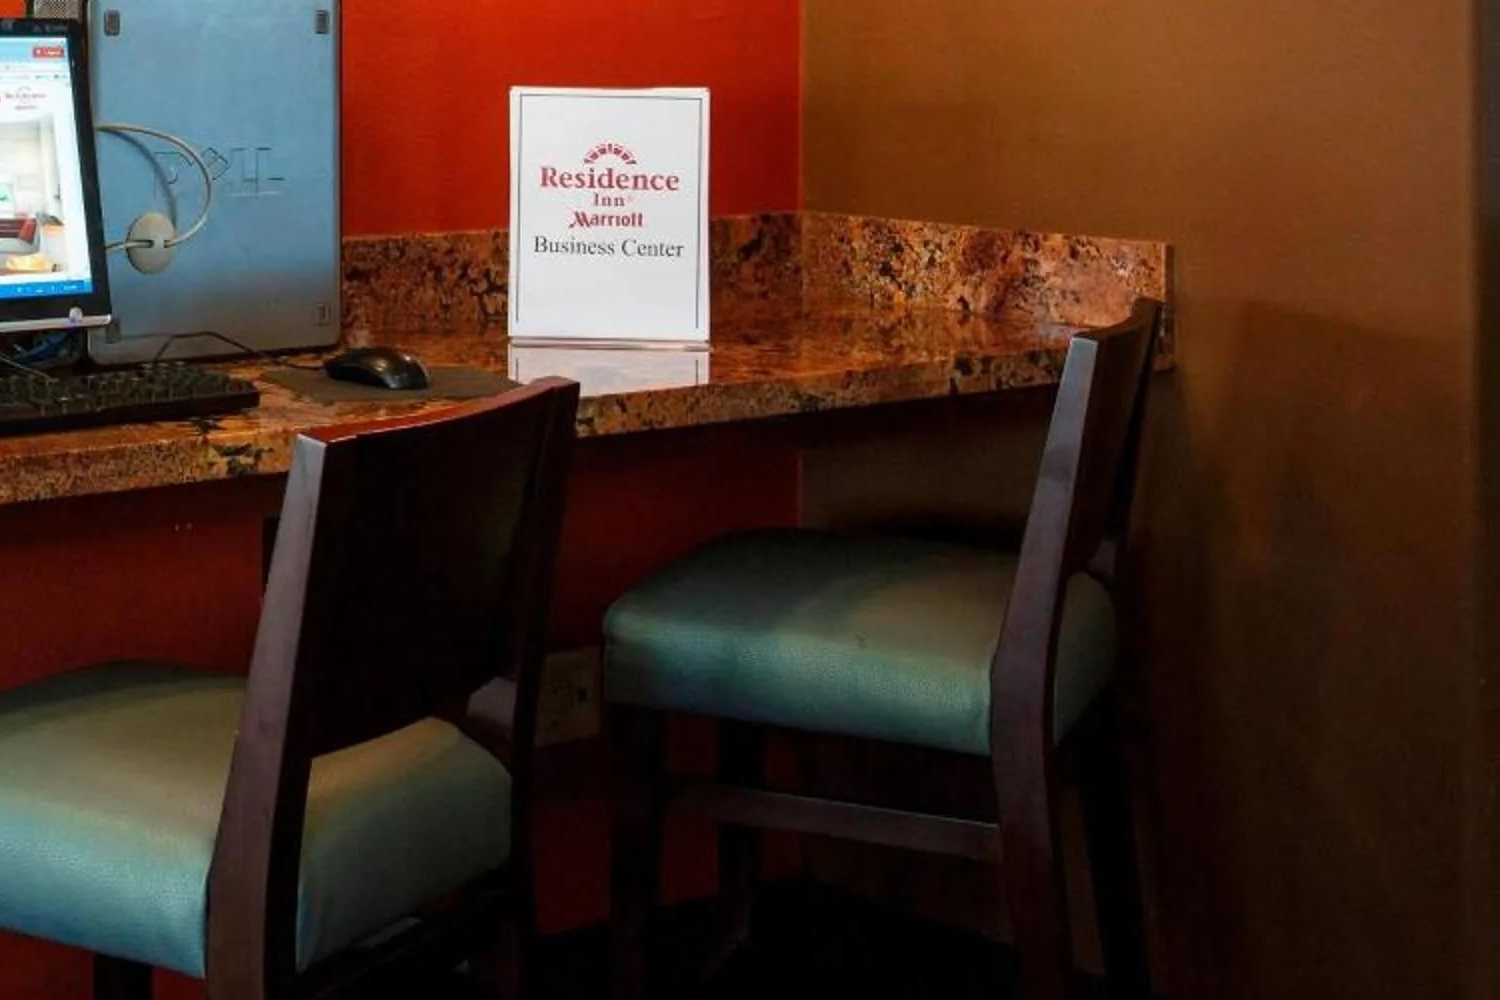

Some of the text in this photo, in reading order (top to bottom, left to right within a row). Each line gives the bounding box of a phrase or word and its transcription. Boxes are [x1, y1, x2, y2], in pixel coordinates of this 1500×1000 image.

[540, 166, 680, 191] Residence
[592, 193, 626, 207] Inn
[568, 211, 644, 229] Marriott
[534, 235, 685, 258] Business Center
